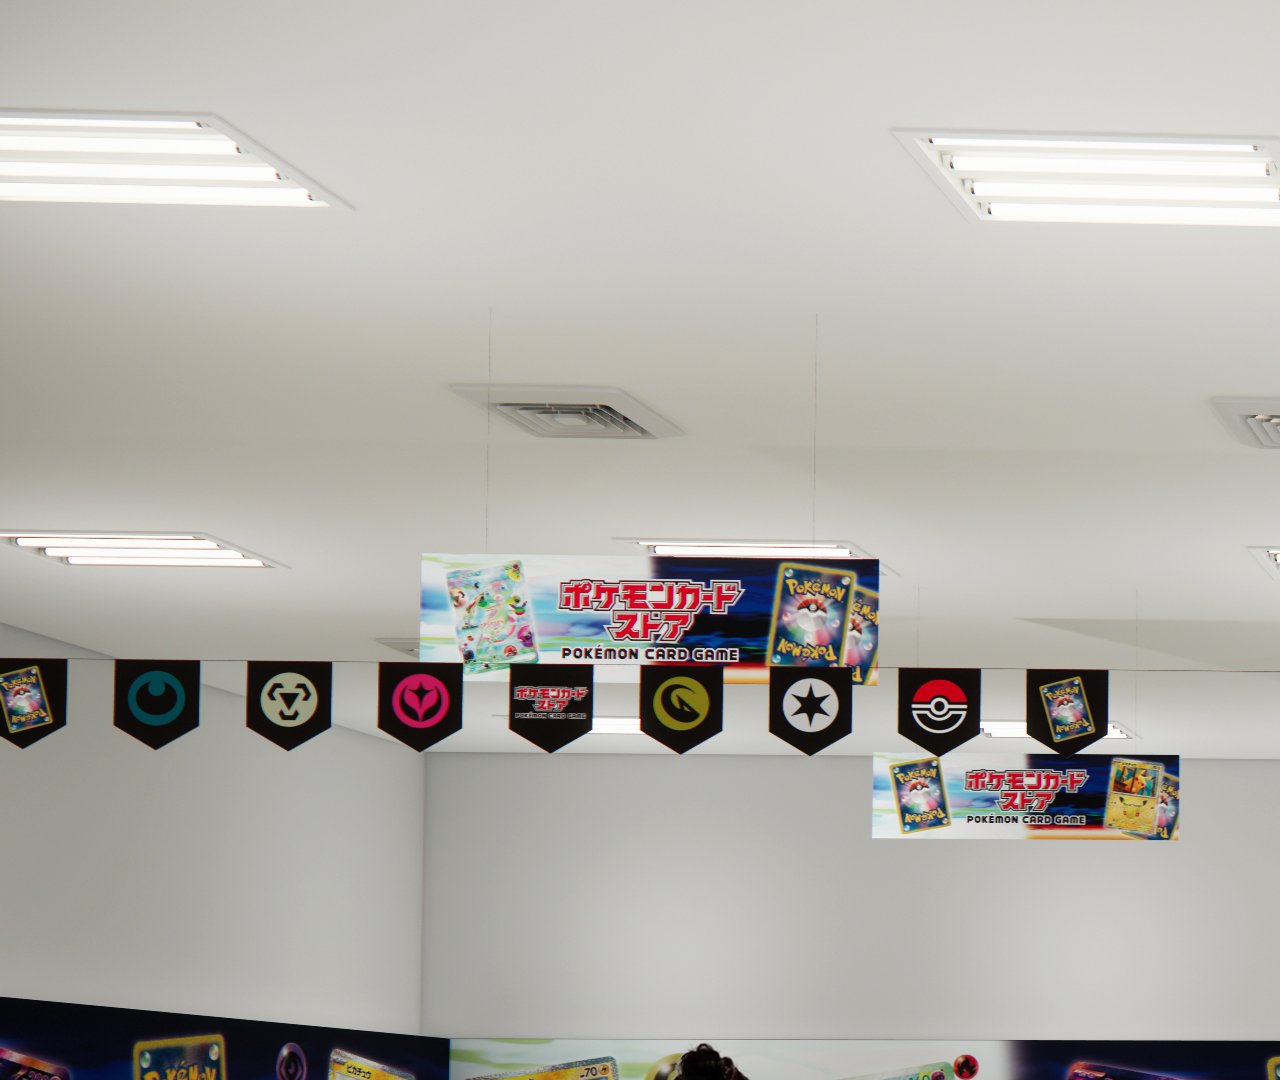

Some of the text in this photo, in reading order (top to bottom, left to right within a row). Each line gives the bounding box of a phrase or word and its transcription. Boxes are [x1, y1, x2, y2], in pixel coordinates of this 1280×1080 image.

[558, 579, 745, 614] ポケモンカード
[603, 611, 695, 643] ストア
[644, 647, 688, 661] CARD
[692, 647, 739, 661] GAME
[963, 768, 1090, 792] ポケモンカード
[995, 790, 1058, 811] ストア
[1022, 815, 1051, 824] CARD
[1055, 815, 1086, 824] GAME
[584, 1066, 597, 1077] 70
